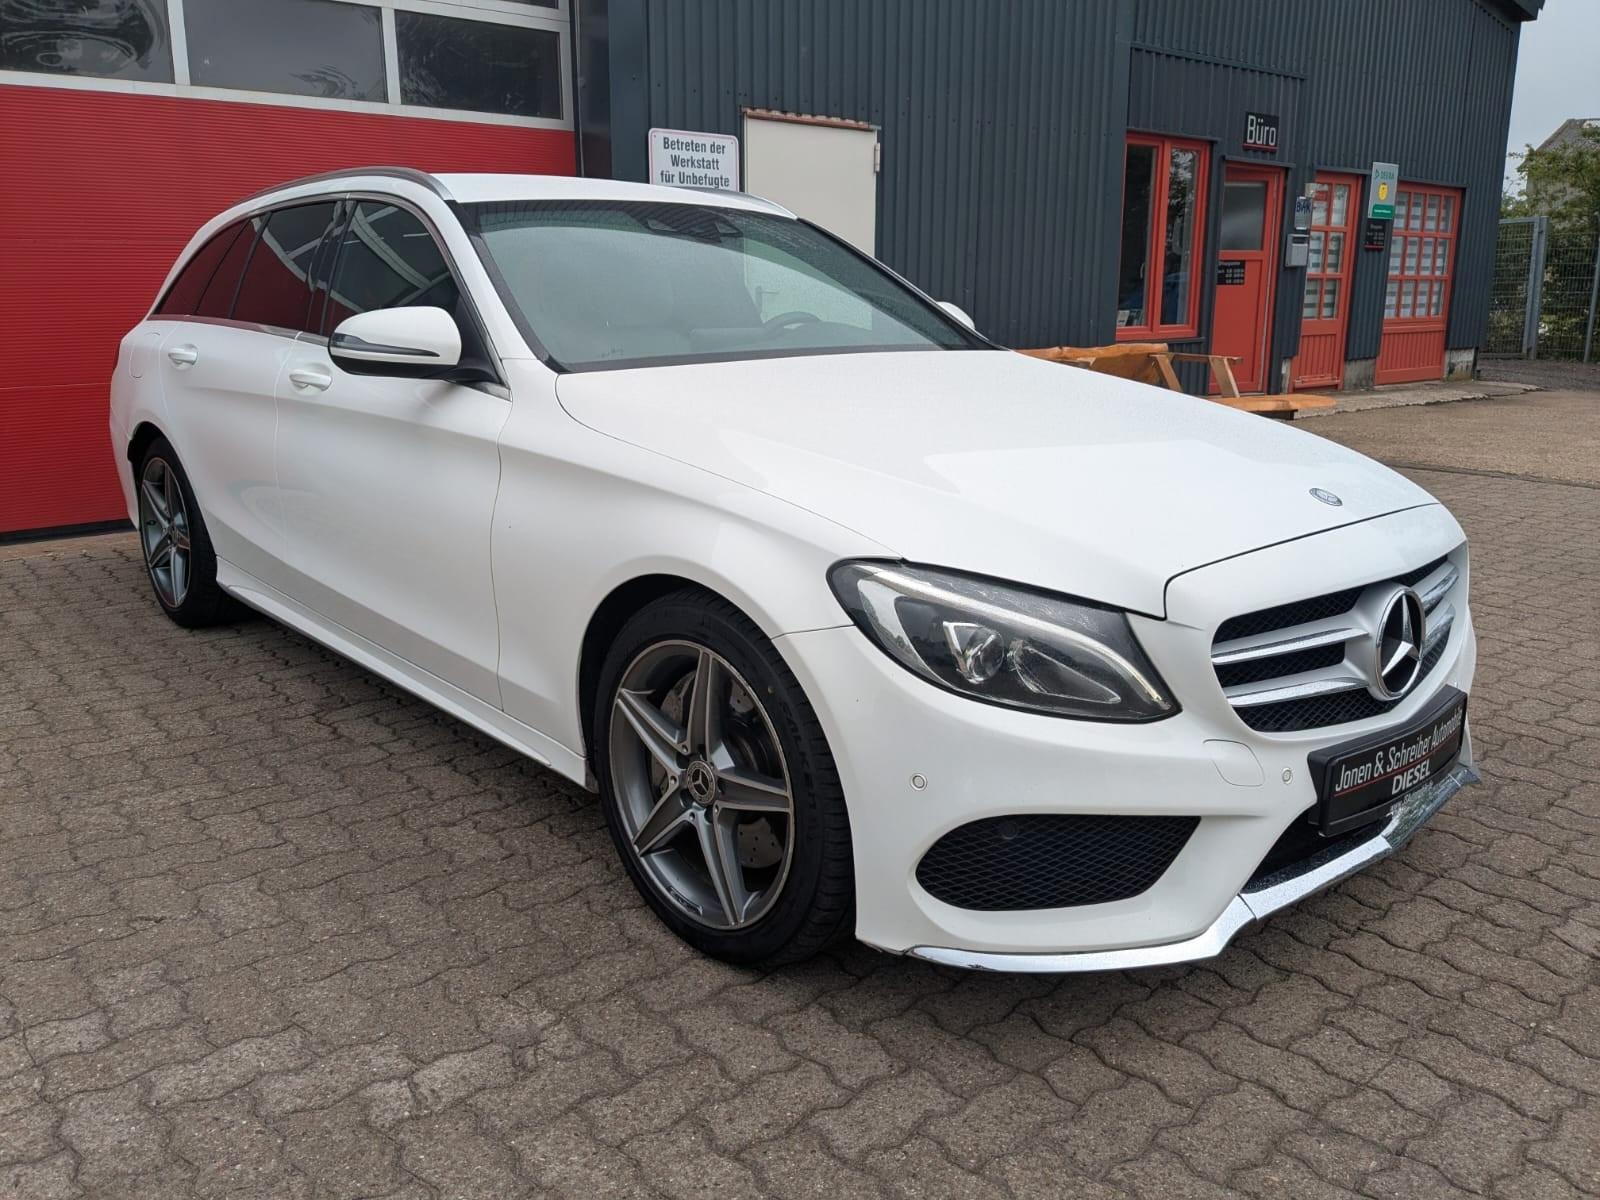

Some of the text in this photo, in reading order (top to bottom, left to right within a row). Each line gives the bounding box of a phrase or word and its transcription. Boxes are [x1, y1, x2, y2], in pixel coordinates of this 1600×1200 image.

[1246, 115, 1277, 146] Büro
[663, 137, 726, 155] Betreten der
[670, 154, 720, 170] Werkstatt
[660, 170, 730, 189] für Unbefugte
[1335, 763, 1372, 792] Jonen
[1373, 751, 1385, 778] &
[1387, 735, 1431, 772] Schreiber
[1391, 759, 1430, 795] DIESEL
